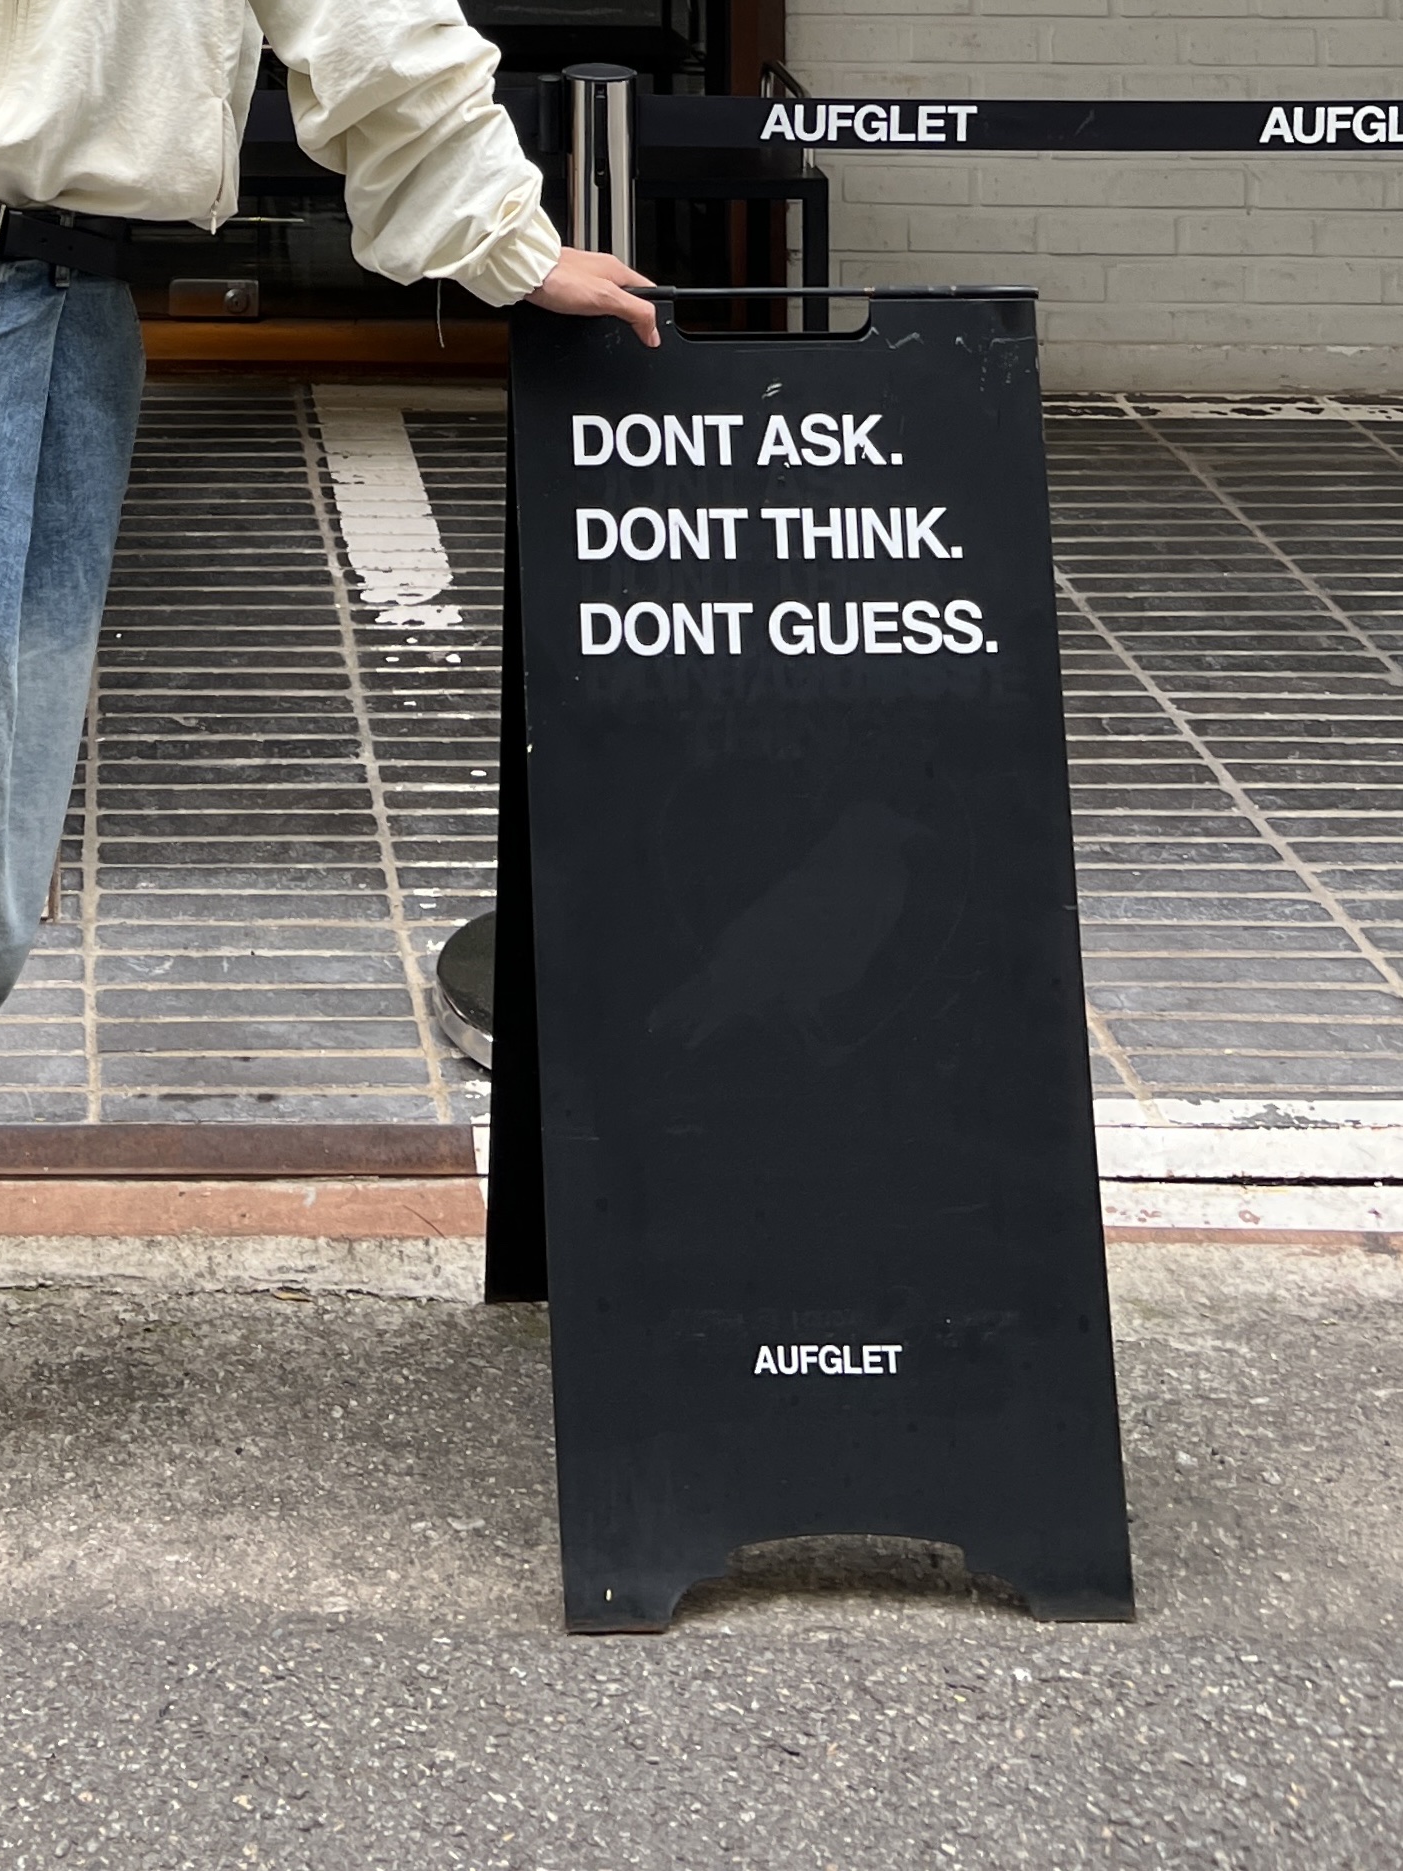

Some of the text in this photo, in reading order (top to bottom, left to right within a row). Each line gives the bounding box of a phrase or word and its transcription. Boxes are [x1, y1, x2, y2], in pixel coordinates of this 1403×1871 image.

[760, 102, 978, 143] AUFGLET
[572, 414, 903, 468] DONT ASK.
[575, 506, 964, 561] DONT THINK.
[579, 599, 999, 656] DONT GUESS.
[754, 1345, 902, 1376] AUFGLET
